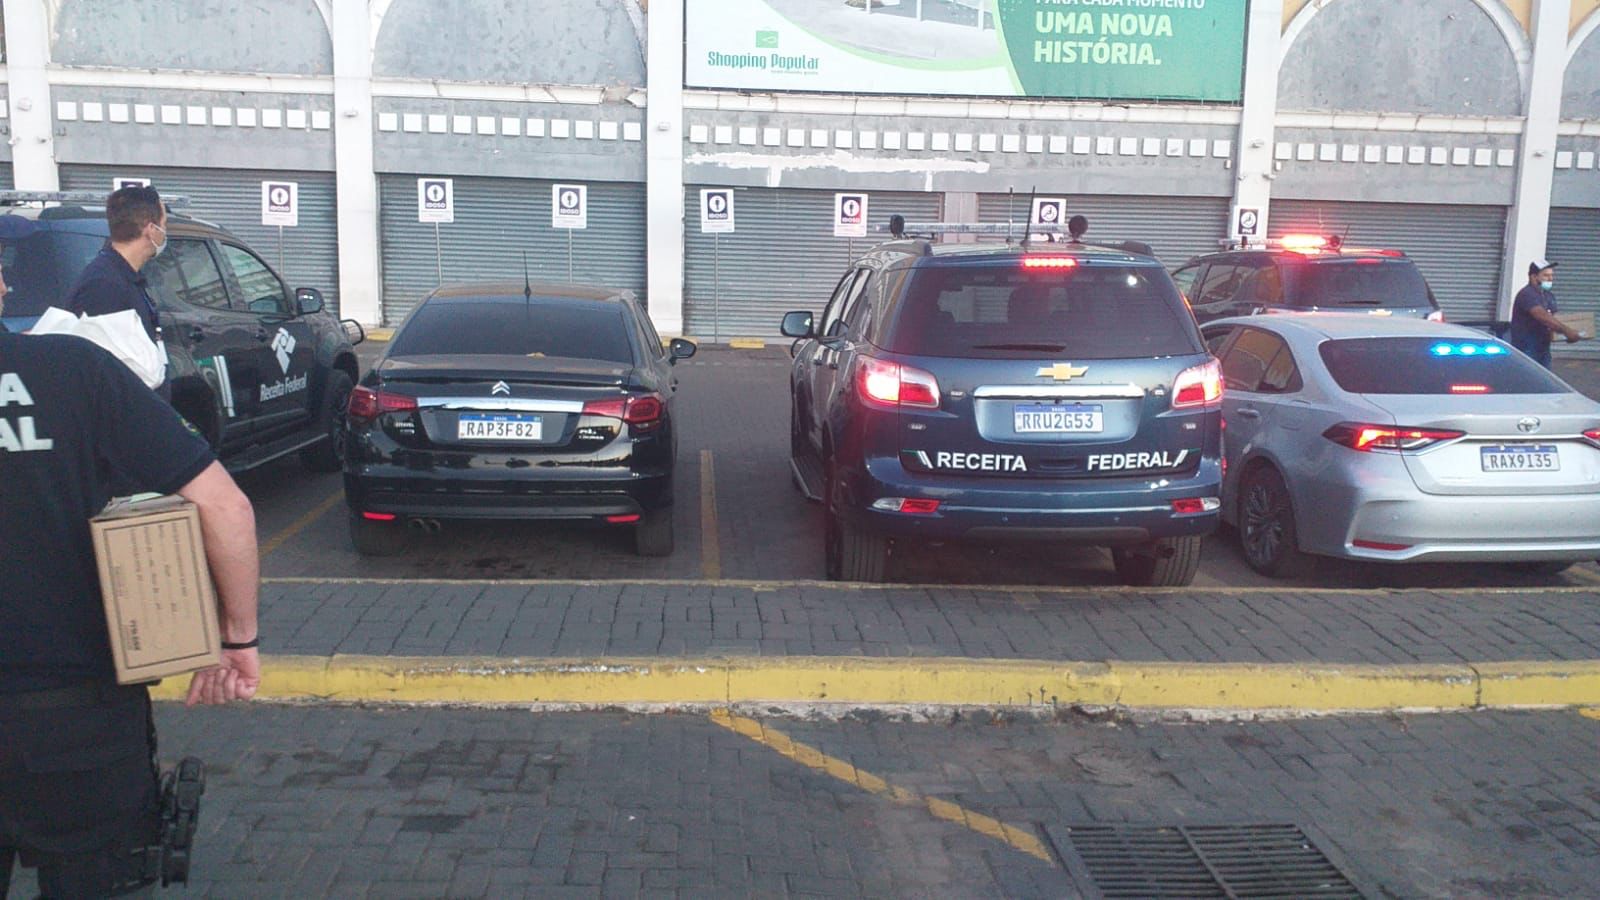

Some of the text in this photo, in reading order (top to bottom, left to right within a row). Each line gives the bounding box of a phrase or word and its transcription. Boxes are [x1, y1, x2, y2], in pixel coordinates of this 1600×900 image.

[1035, 11, 1173, 37] UMA NOVA
[707, 51, 819, 70] Shopping Popular
[1034, 36, 1162, 65] HISTÓRIA.
[260, 371, 307, 402] Receita Federal
[466, 423, 533, 437] RAP3F82
[1022, 413, 1094, 430] RRU2G53
[937, 451, 1173, 472] RECEITA FEDERAL
